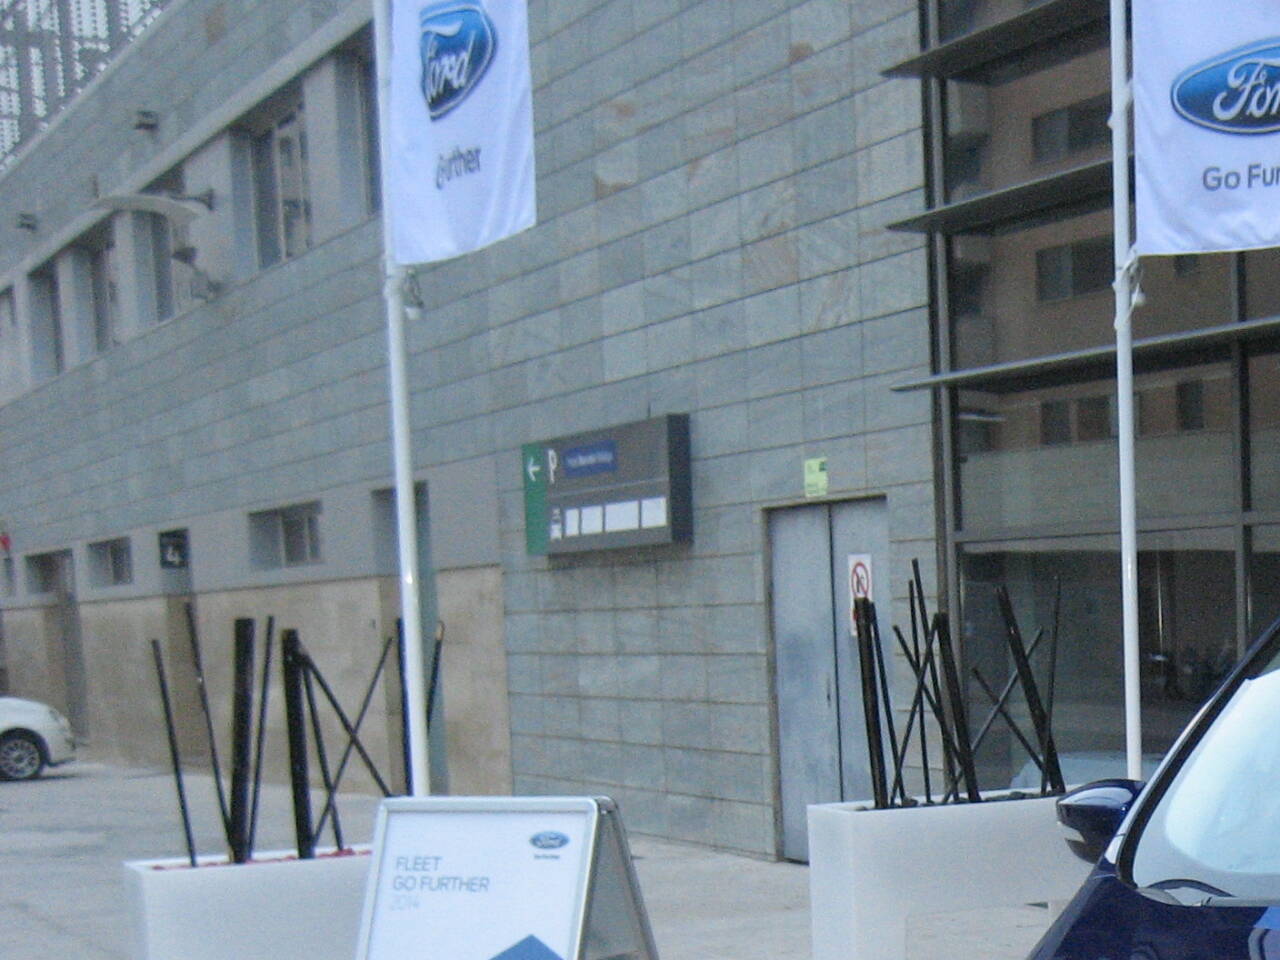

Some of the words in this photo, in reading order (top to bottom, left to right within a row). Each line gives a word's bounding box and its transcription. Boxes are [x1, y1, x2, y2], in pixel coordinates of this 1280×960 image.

[1202, 166, 1240, 191] Go
[396, 856, 442, 872] FLEET
[393, 875, 416, 891] GO
[420, 876, 489, 892] FURTHER
